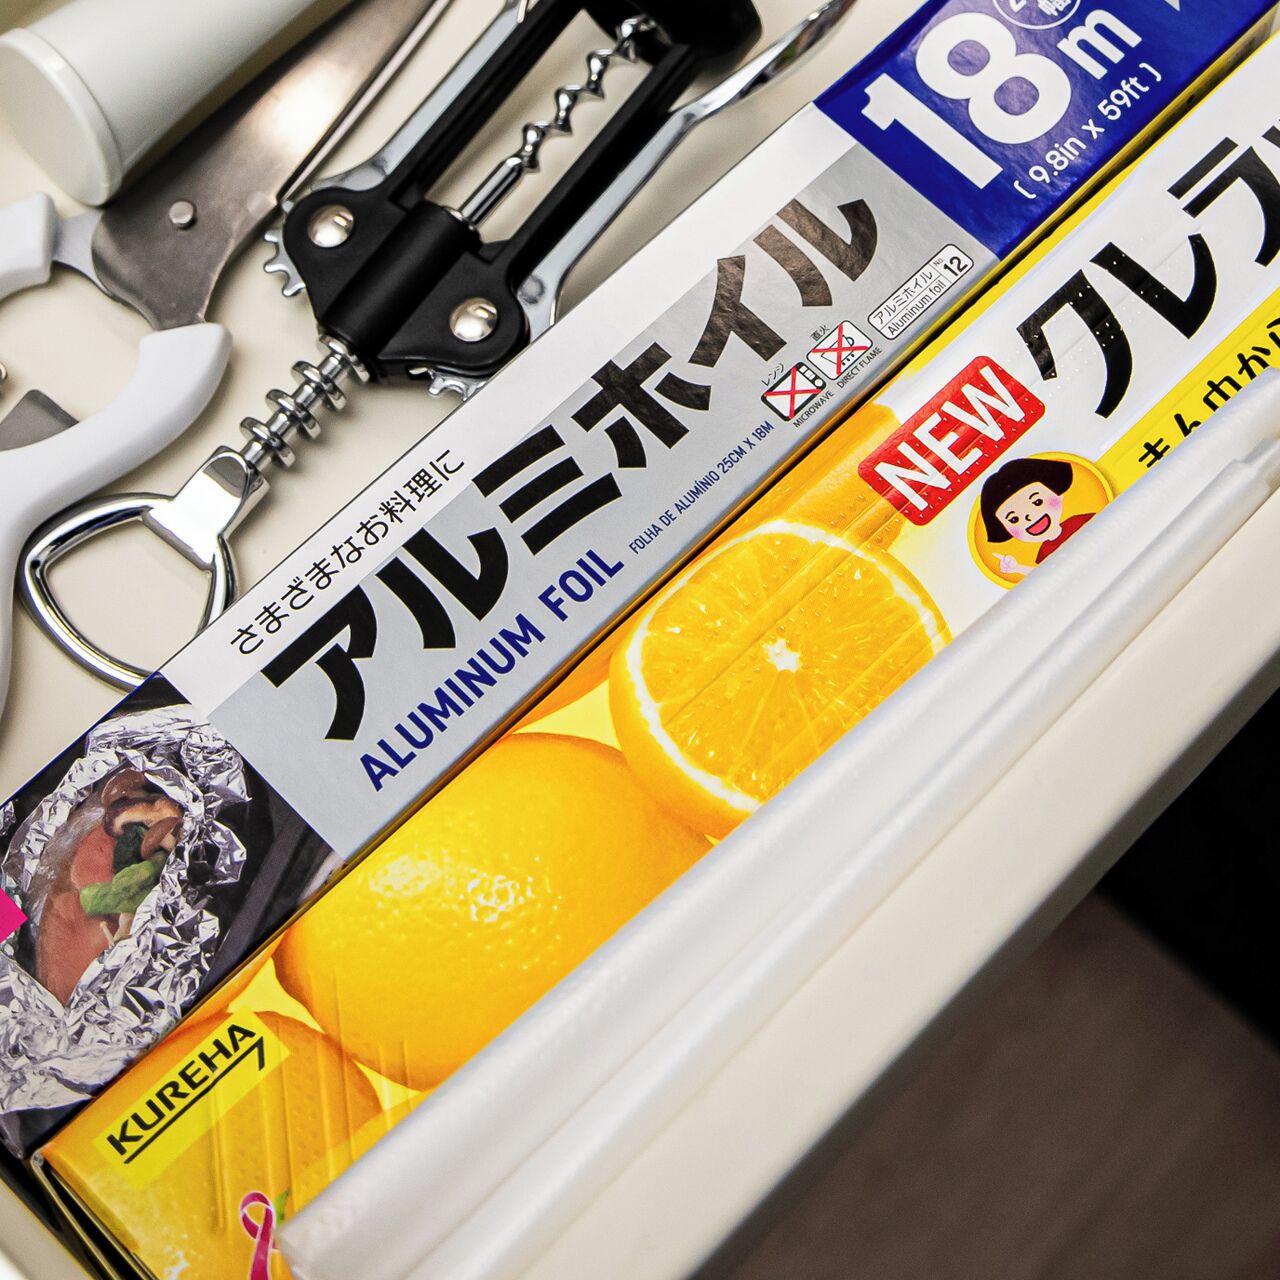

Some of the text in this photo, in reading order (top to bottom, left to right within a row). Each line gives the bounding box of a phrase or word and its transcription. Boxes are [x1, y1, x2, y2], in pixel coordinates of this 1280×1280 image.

[861, 7, 1143, 190] 18m
[872, 268, 934, 325] アルミホイル
[886, 280, 948, 337] Aluminum foil
[942, 255, 969, 277] 12
[792, 389, 836, 429] MICROWAVE
[836, 346, 883, 389] DIRECT FLAME
[260, 196, 880, 742] アルミホイル
[628, 523, 664, 555] FOLHA
[658, 509, 678, 528] DE
[673, 469, 721, 515] ALUMÍNIO
[716, 444, 748, 475] 25CM
[750, 420, 775, 442] 18M
[874, 364, 1029, 513] NEW
[229, 448, 466, 656] さまざまなお料理に
[358, 546, 626, 794] ALUMINUM FOIL
[106, 1023, 258, 1156] KUREHA
